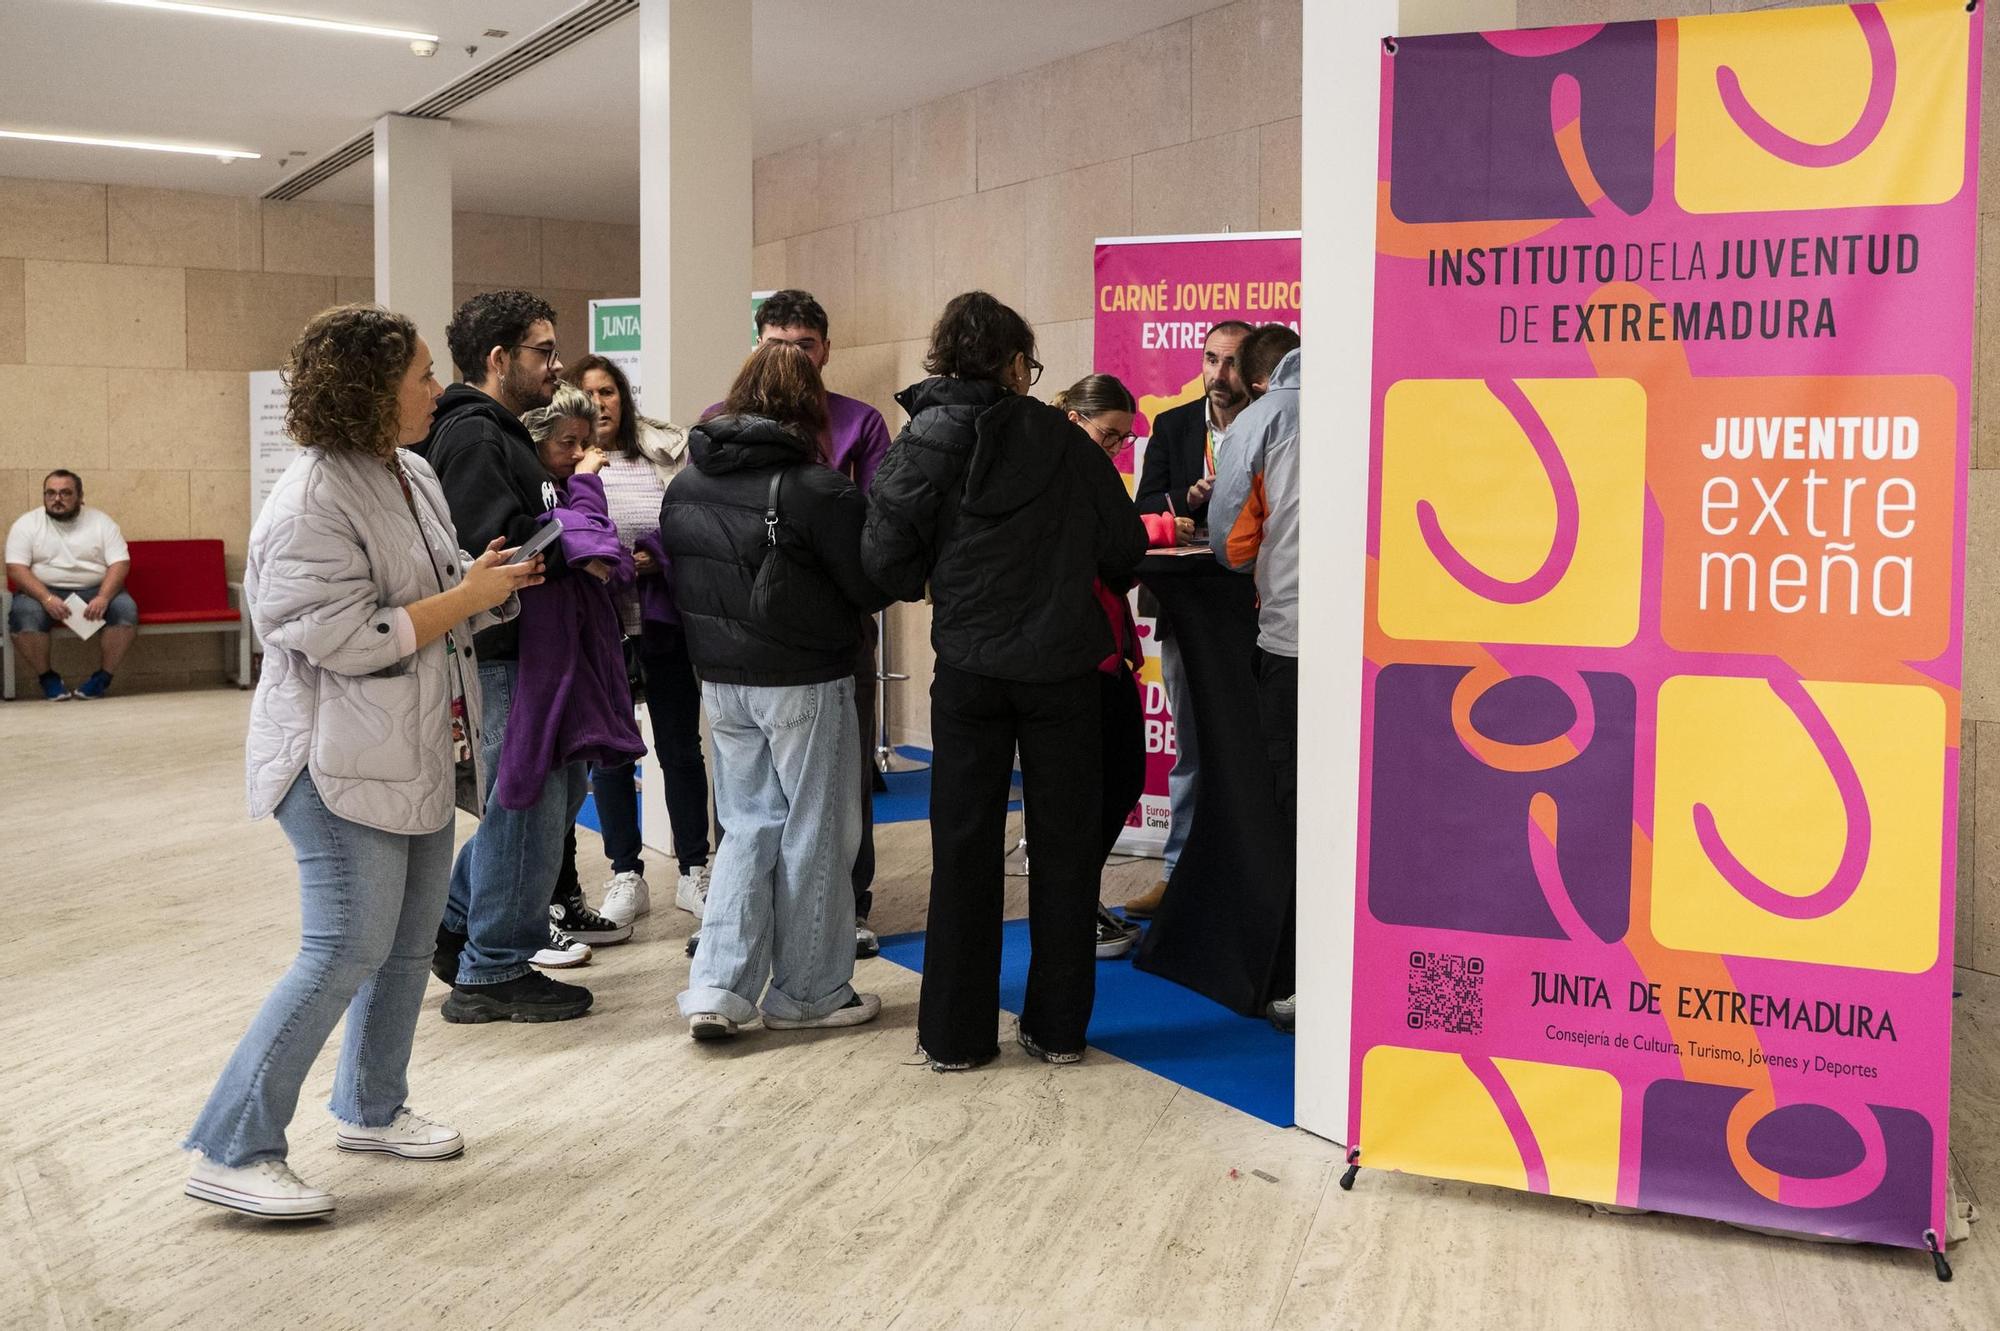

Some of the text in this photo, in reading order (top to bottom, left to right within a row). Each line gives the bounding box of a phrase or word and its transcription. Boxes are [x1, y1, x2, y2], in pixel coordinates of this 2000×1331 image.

[1428, 243, 1616, 287] INSTITUTO
[1715, 233, 1920, 281] JUVENTUD
[1100, 279, 1168, 312] CARNÉ
[1172, 282, 1240, 312] JOVEN
[602, 315, 640, 340] JUNTA
[1499, 297, 1837, 344] DE EXTREMADURA
[1700, 416, 1920, 461] JUVENTUD
[1701, 468, 1917, 539] extre
[1699, 542, 1913, 617] meña
[1146, 804, 1171, 818] Europ
[1146, 816, 1169, 829] Carné
[1531, 971, 1898, 1042] JUNTA DE EXTREMADURA
[1545, 1024, 1879, 1079] Consejería de Cultura, Turismo, Jóvenes y Deportes
